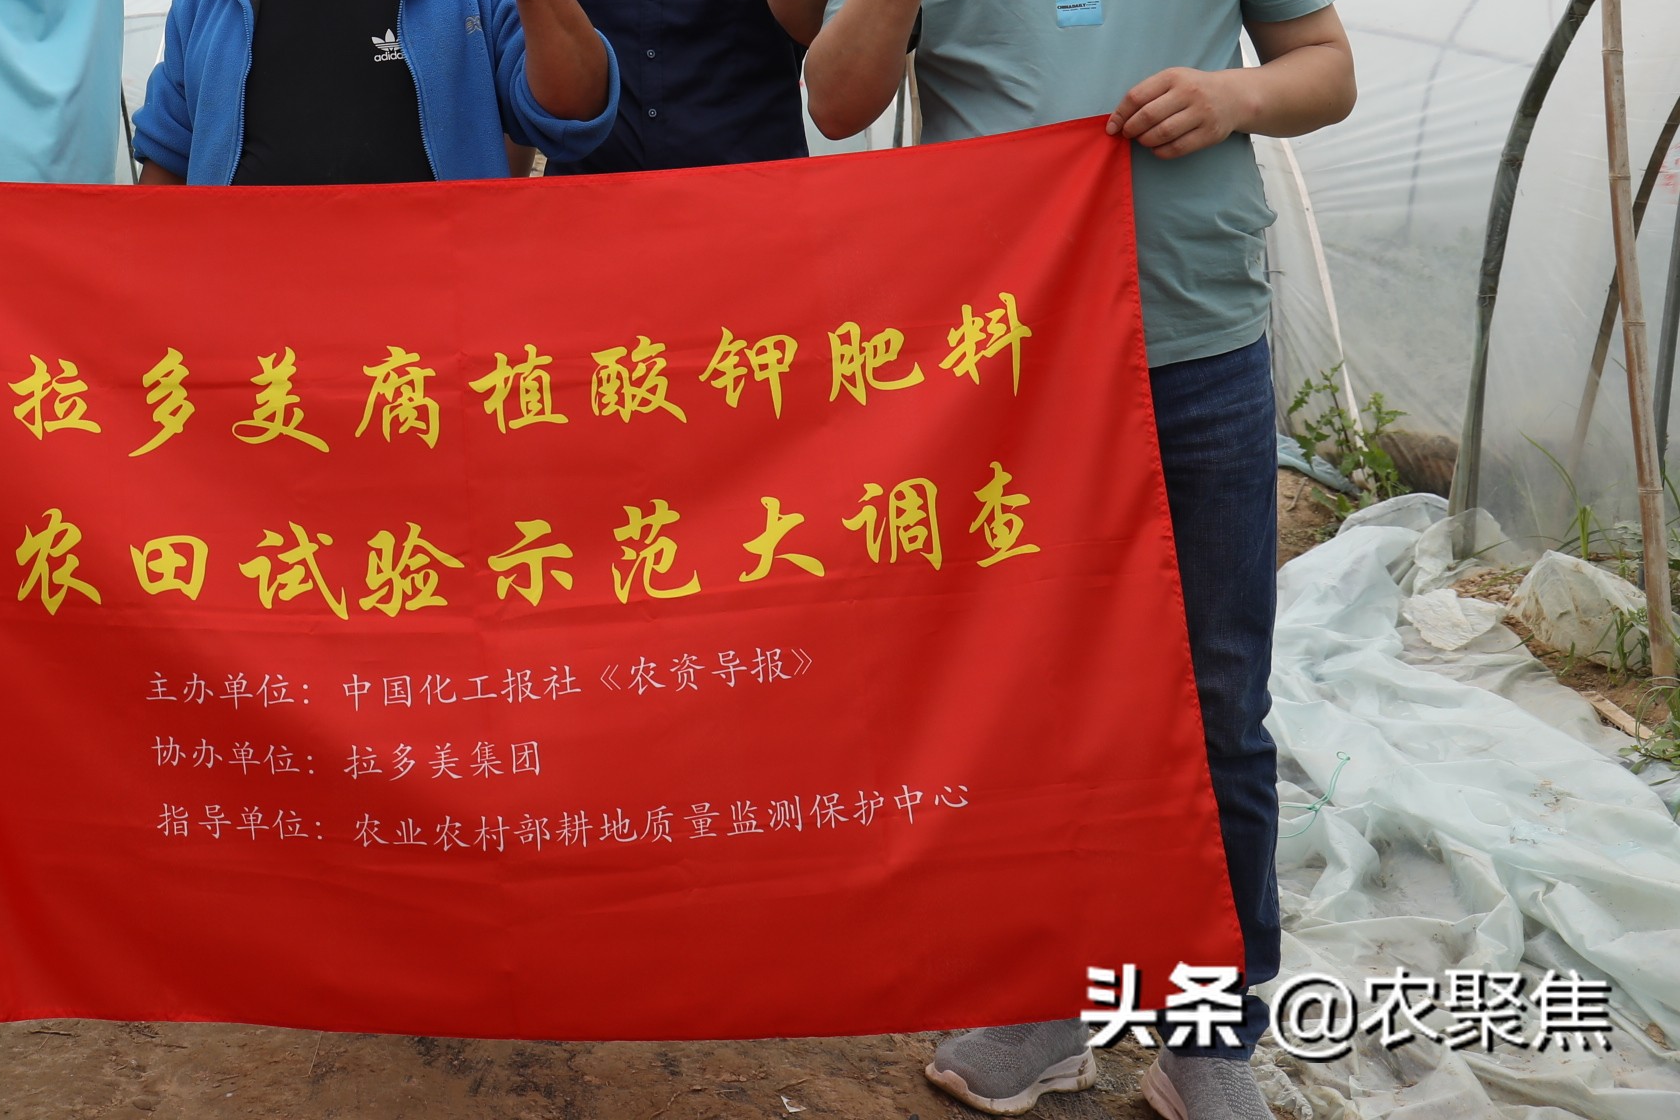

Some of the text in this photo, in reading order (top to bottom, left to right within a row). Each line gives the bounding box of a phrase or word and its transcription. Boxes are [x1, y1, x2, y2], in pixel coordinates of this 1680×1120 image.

[374, 51, 404, 62] adida
[8, 291, 1032, 457] 拉多美腐植酸钾肥料
[15, 461, 1041, 621] 农田试验示范大调查
